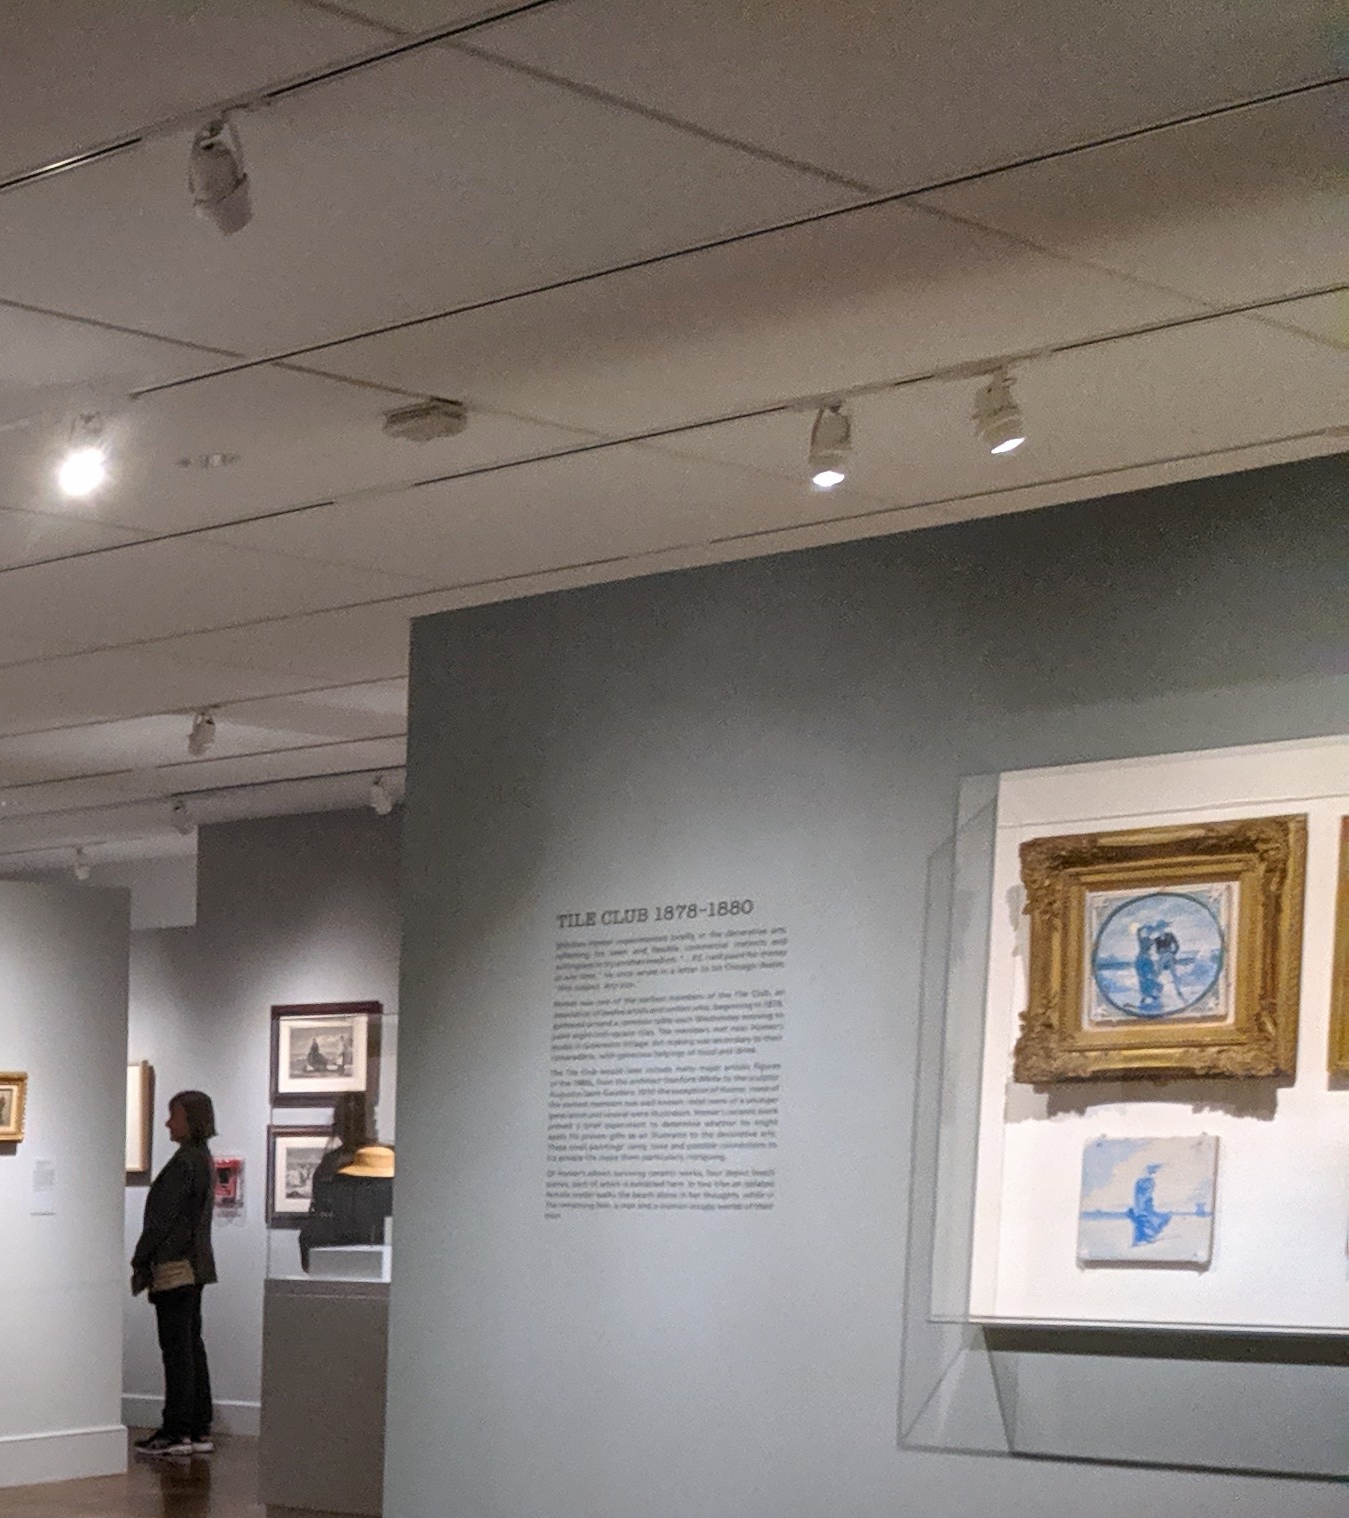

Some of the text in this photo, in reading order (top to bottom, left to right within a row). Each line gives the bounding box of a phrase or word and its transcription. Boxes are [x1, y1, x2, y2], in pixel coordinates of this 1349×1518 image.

[557, 899, 754, 928] TILE CLUB 1878-1880
